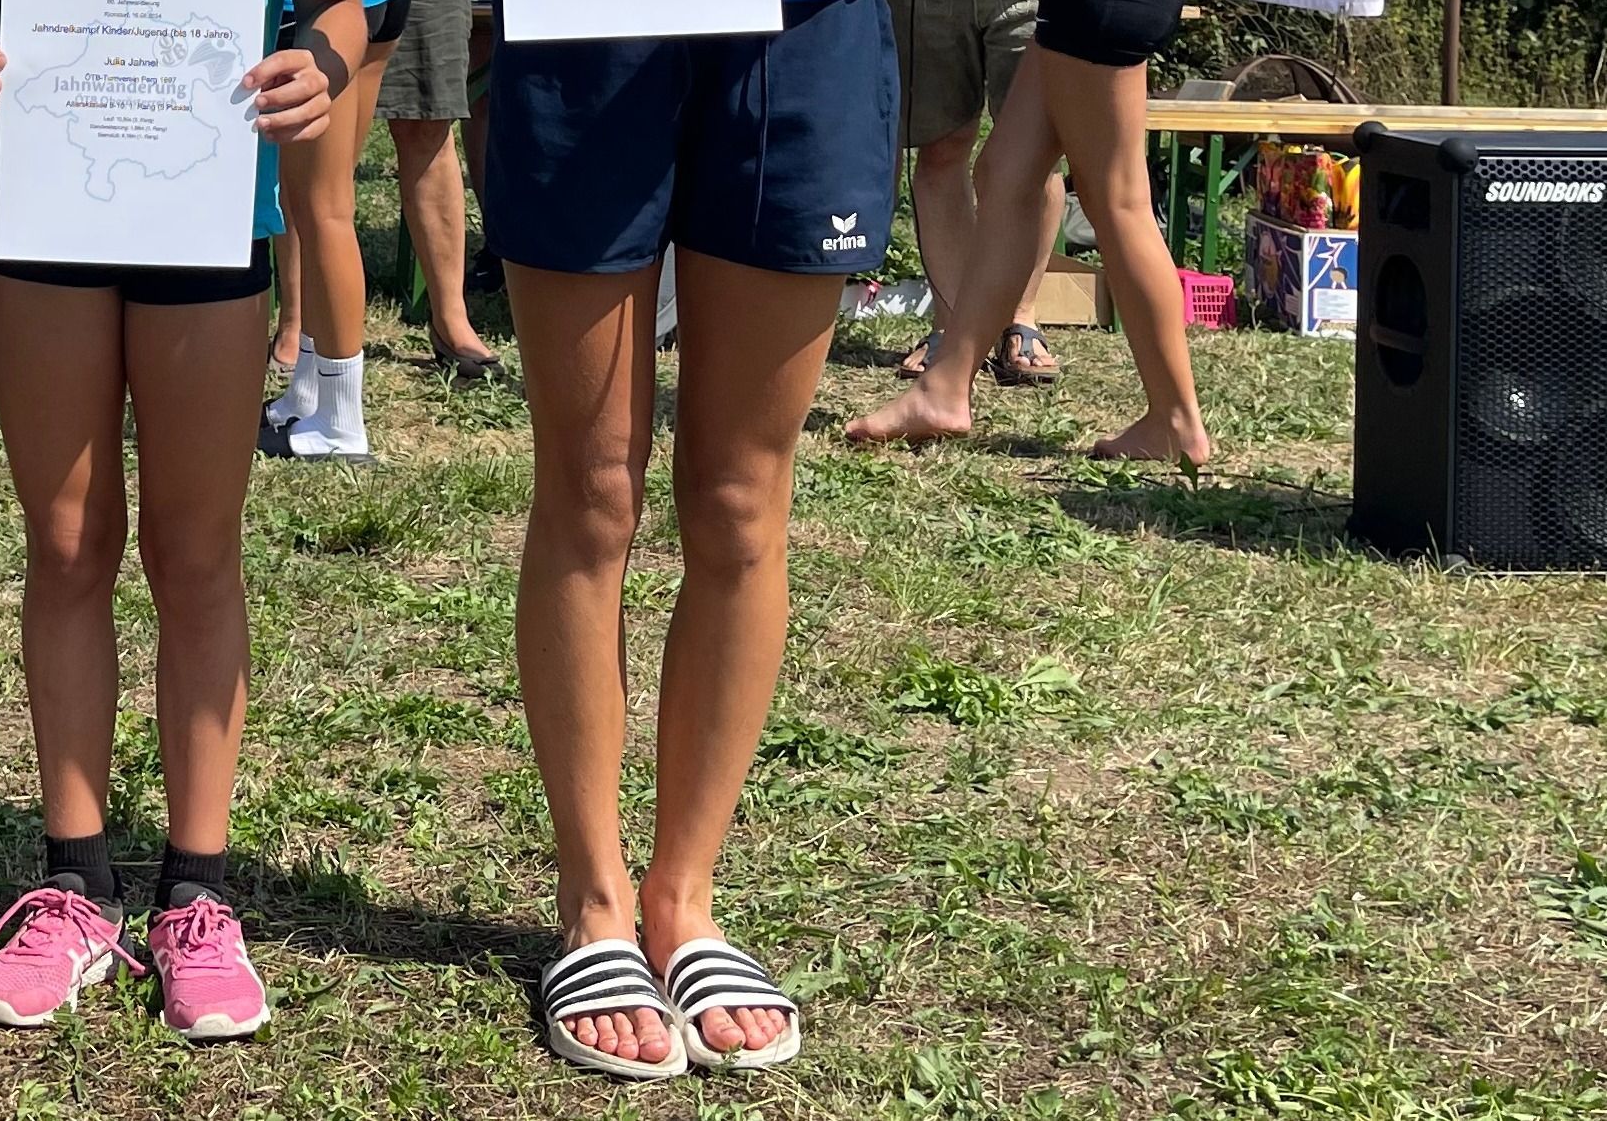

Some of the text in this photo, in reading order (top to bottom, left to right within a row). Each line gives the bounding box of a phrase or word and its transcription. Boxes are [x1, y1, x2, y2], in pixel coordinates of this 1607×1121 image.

[32, 24, 233, 40] Jahndreikampf Kinder/Jugend (bis 18 Jahre)
[104, 58, 126, 67] Julia
[54, 76, 187, 99] Jahnwanderung
[1485, 181, 1606, 203] SOUNDBOKS
[822, 234, 867, 251] erima
